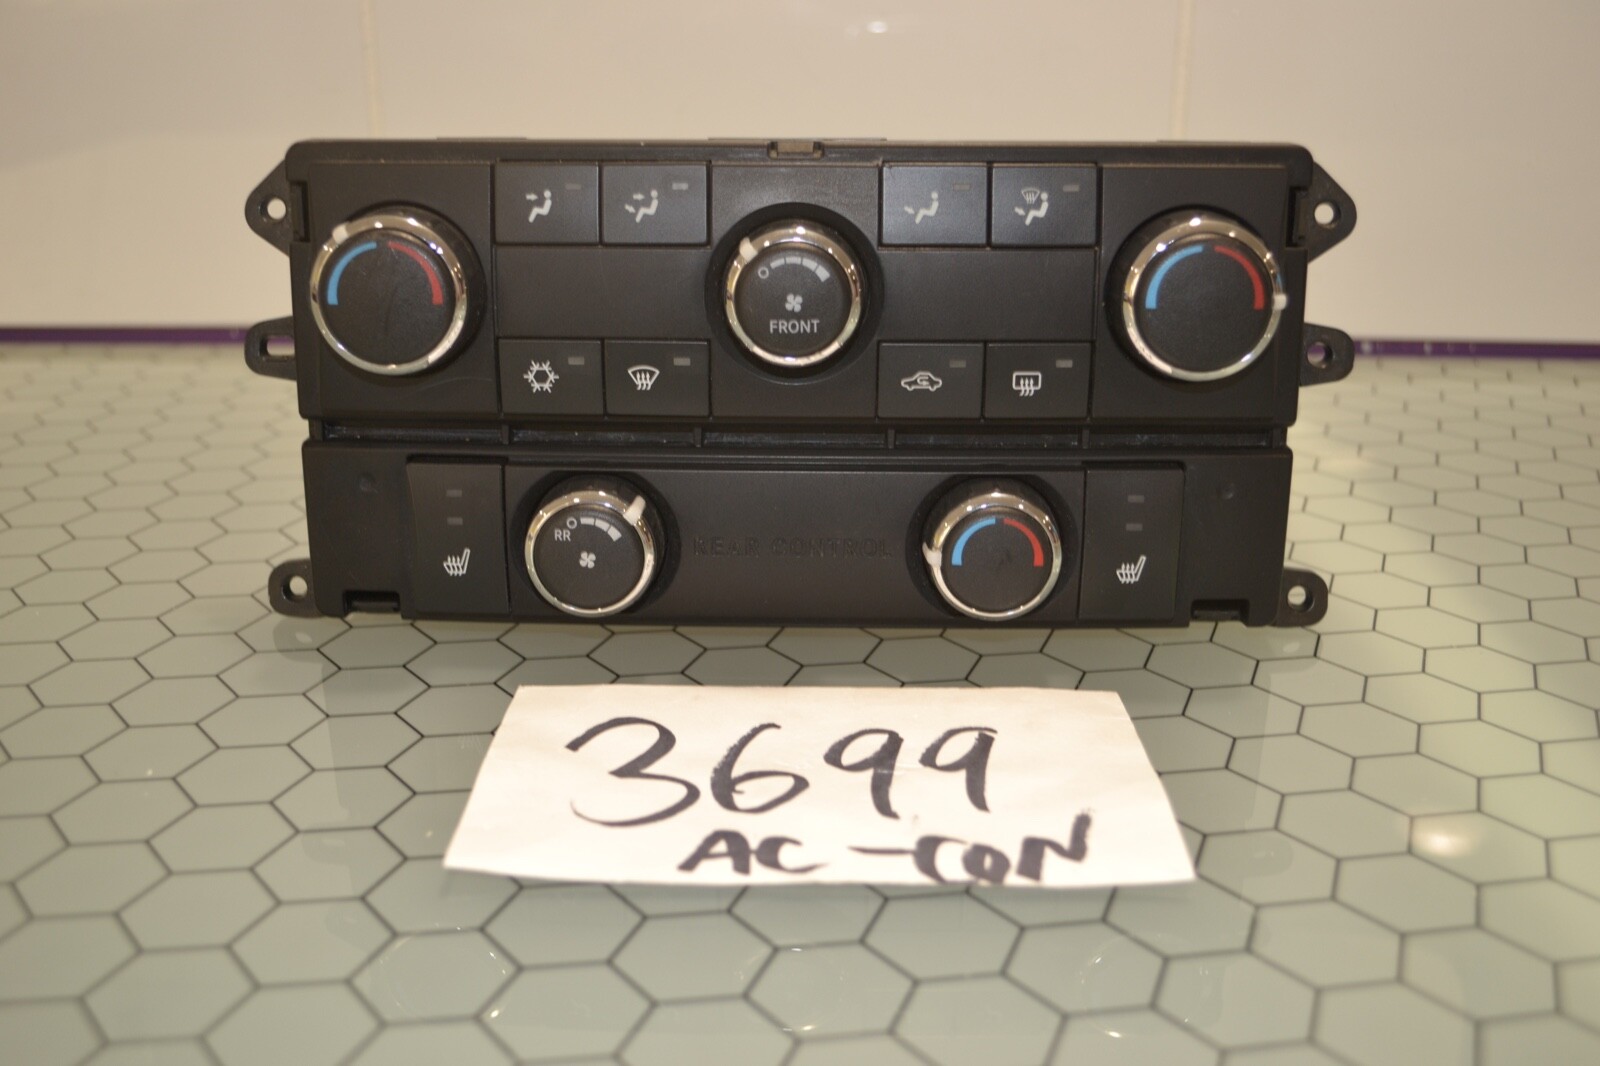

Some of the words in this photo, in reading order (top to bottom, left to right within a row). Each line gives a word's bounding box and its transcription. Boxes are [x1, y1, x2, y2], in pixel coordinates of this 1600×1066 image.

[769, 319, 820, 334] FRONT
[554, 528, 571, 541] RR
[693, 537, 761, 558] REAR
[771, 537, 895, 560] CONTROL
[565, 716, 998, 827] 3699
